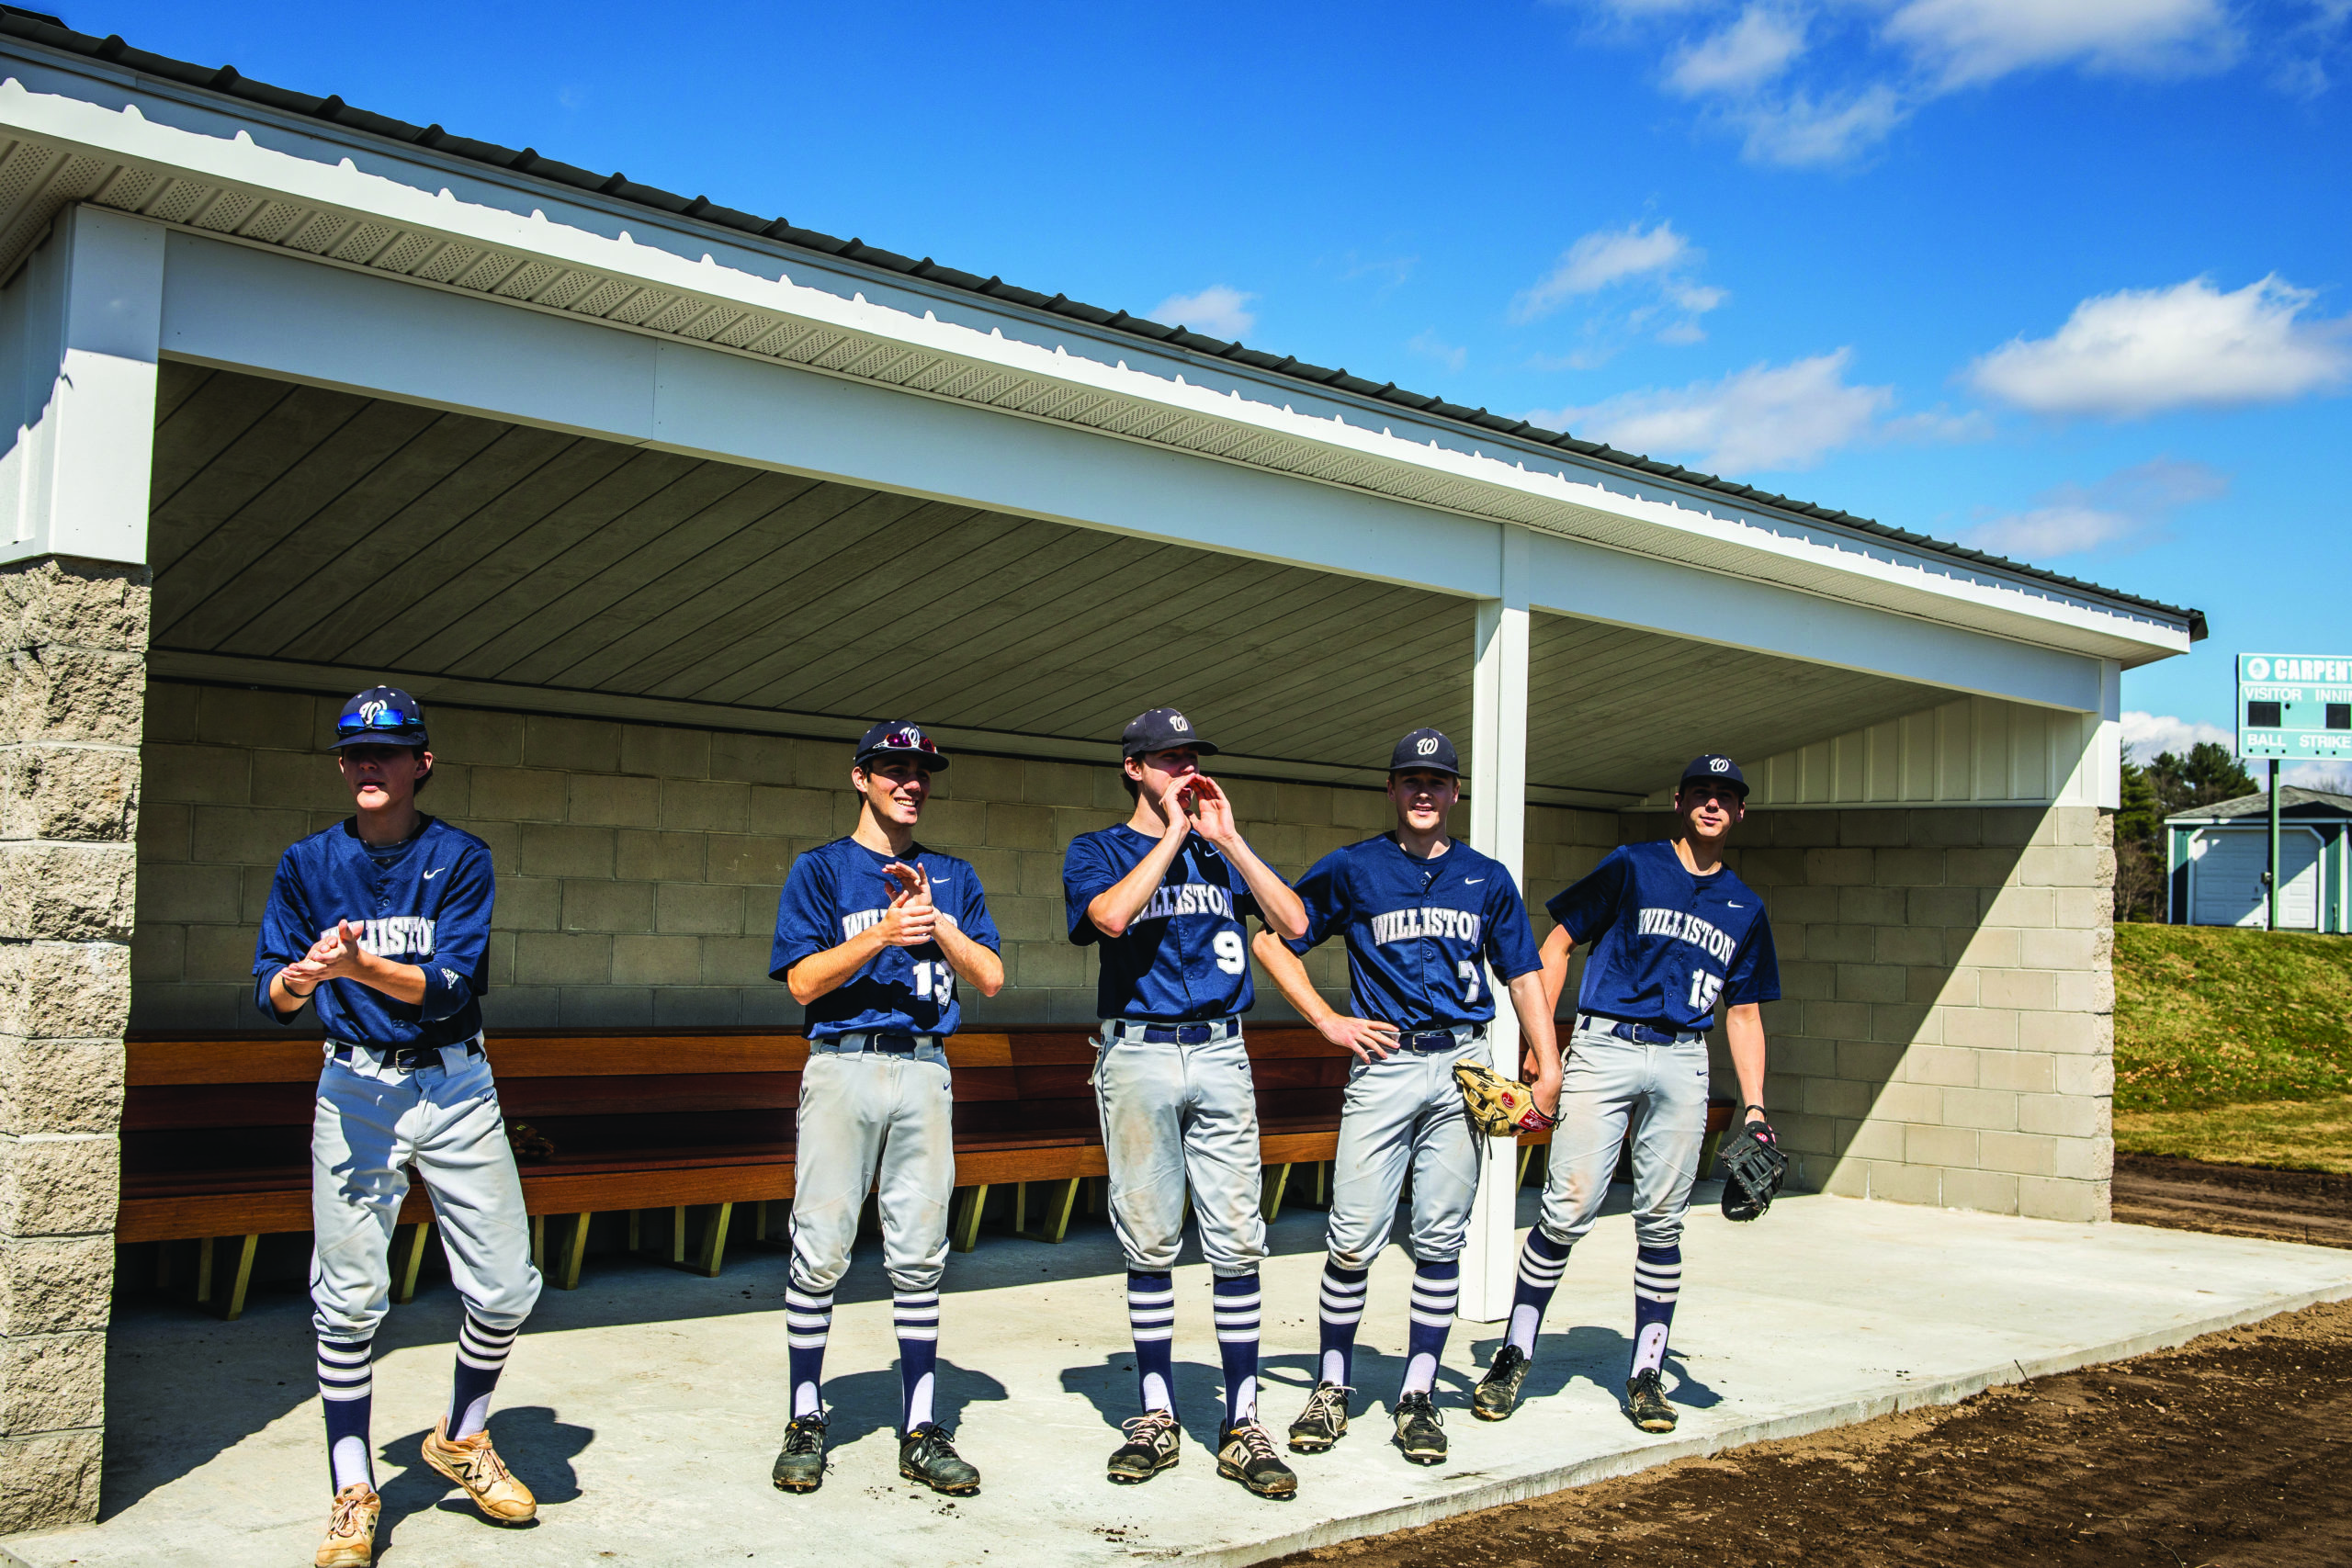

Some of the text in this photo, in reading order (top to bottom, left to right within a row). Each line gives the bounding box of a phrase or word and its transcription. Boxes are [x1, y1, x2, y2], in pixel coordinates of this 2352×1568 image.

[2245, 687, 2302, 702] VISITOR
[1169, 716, 1189, 732] W
[1416, 737, 1439, 755] W
[2247, 733, 2352, 750] BALL STRIKE
[1710, 758, 1729, 773] W
[1213, 930, 1246, 975] 9
[1637, 908, 1737, 967] WILLISTON
[913, 958, 956, 1007] 13
[1458, 960, 1481, 1003] 7
[1688, 967, 1725, 1015] 15
